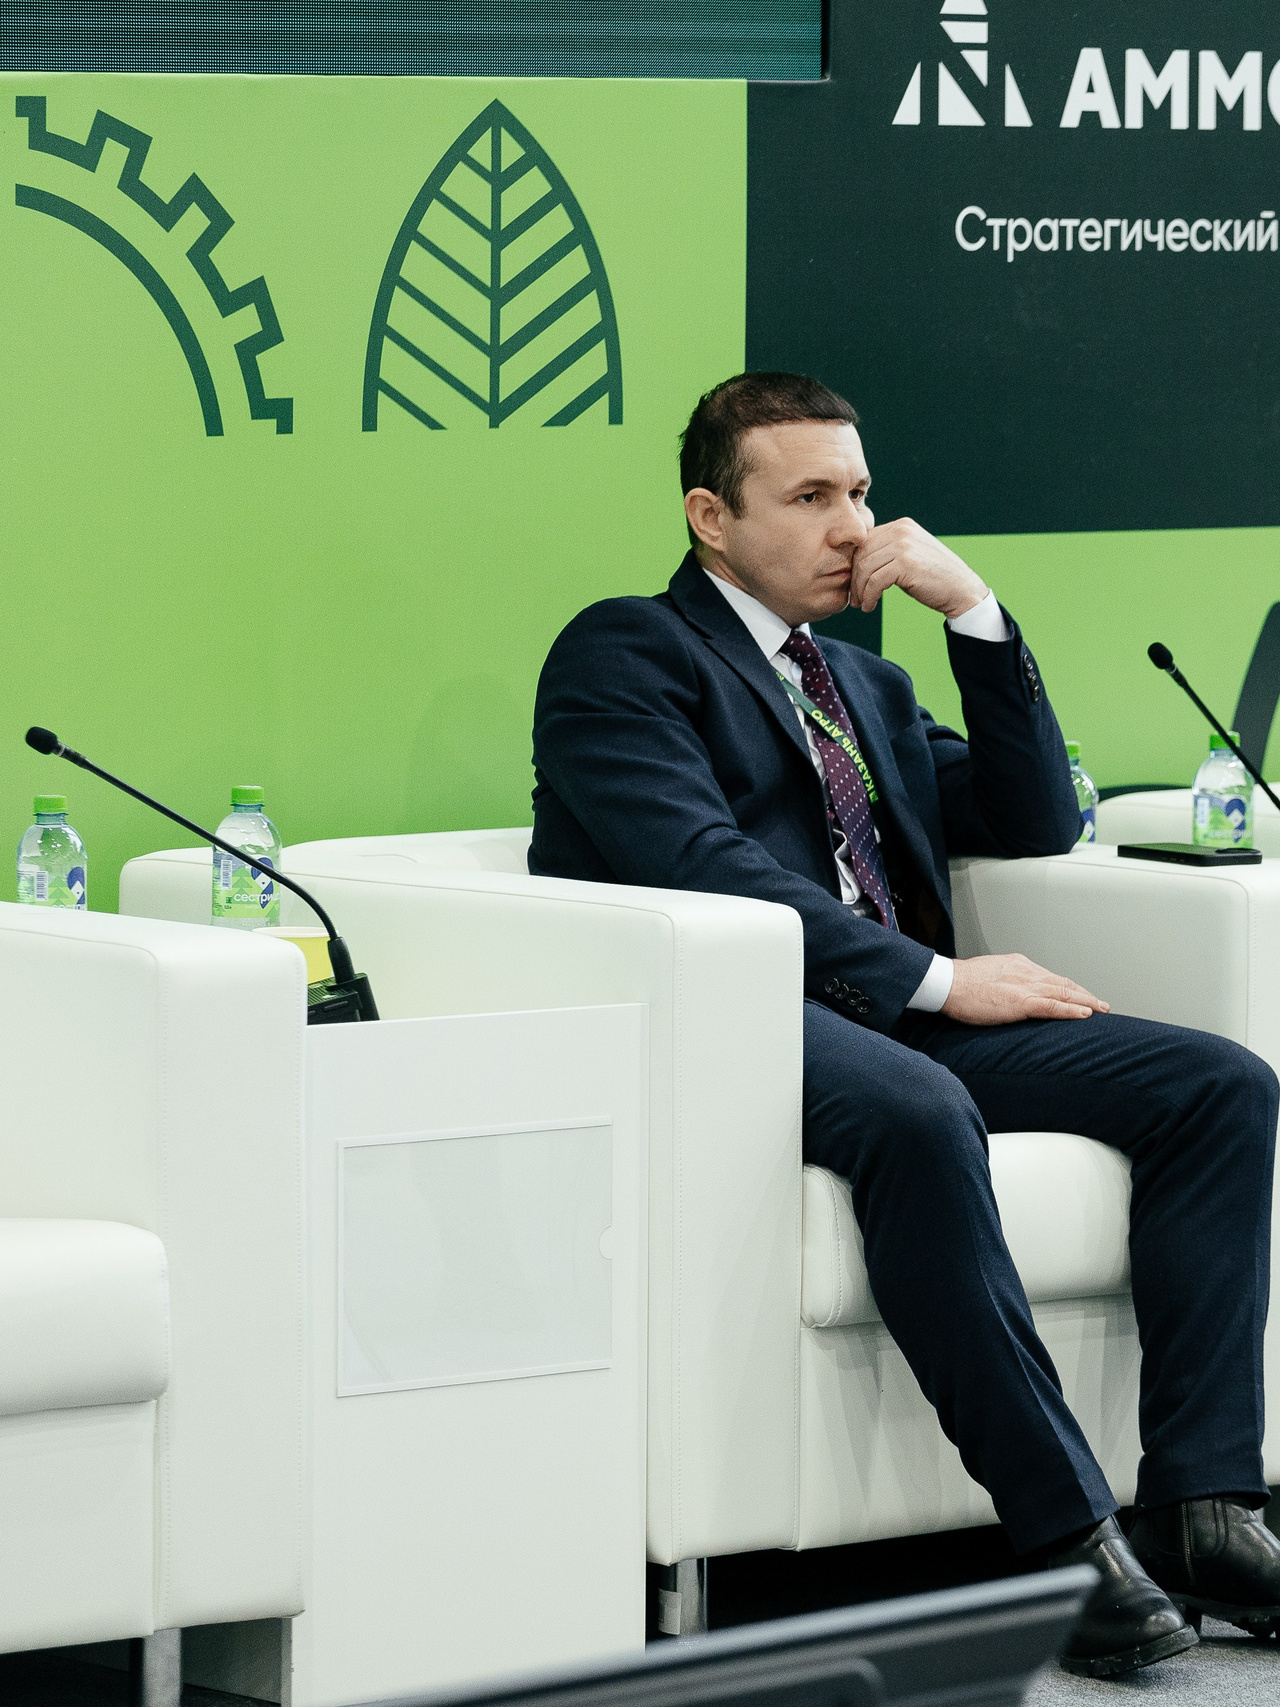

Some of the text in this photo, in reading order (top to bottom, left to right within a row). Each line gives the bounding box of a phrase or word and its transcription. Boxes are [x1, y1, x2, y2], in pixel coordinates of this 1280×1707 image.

[955, 206, 1278, 262] Стратегический
[811, 708, 875, 792] КАЗАНЬ АГРО
